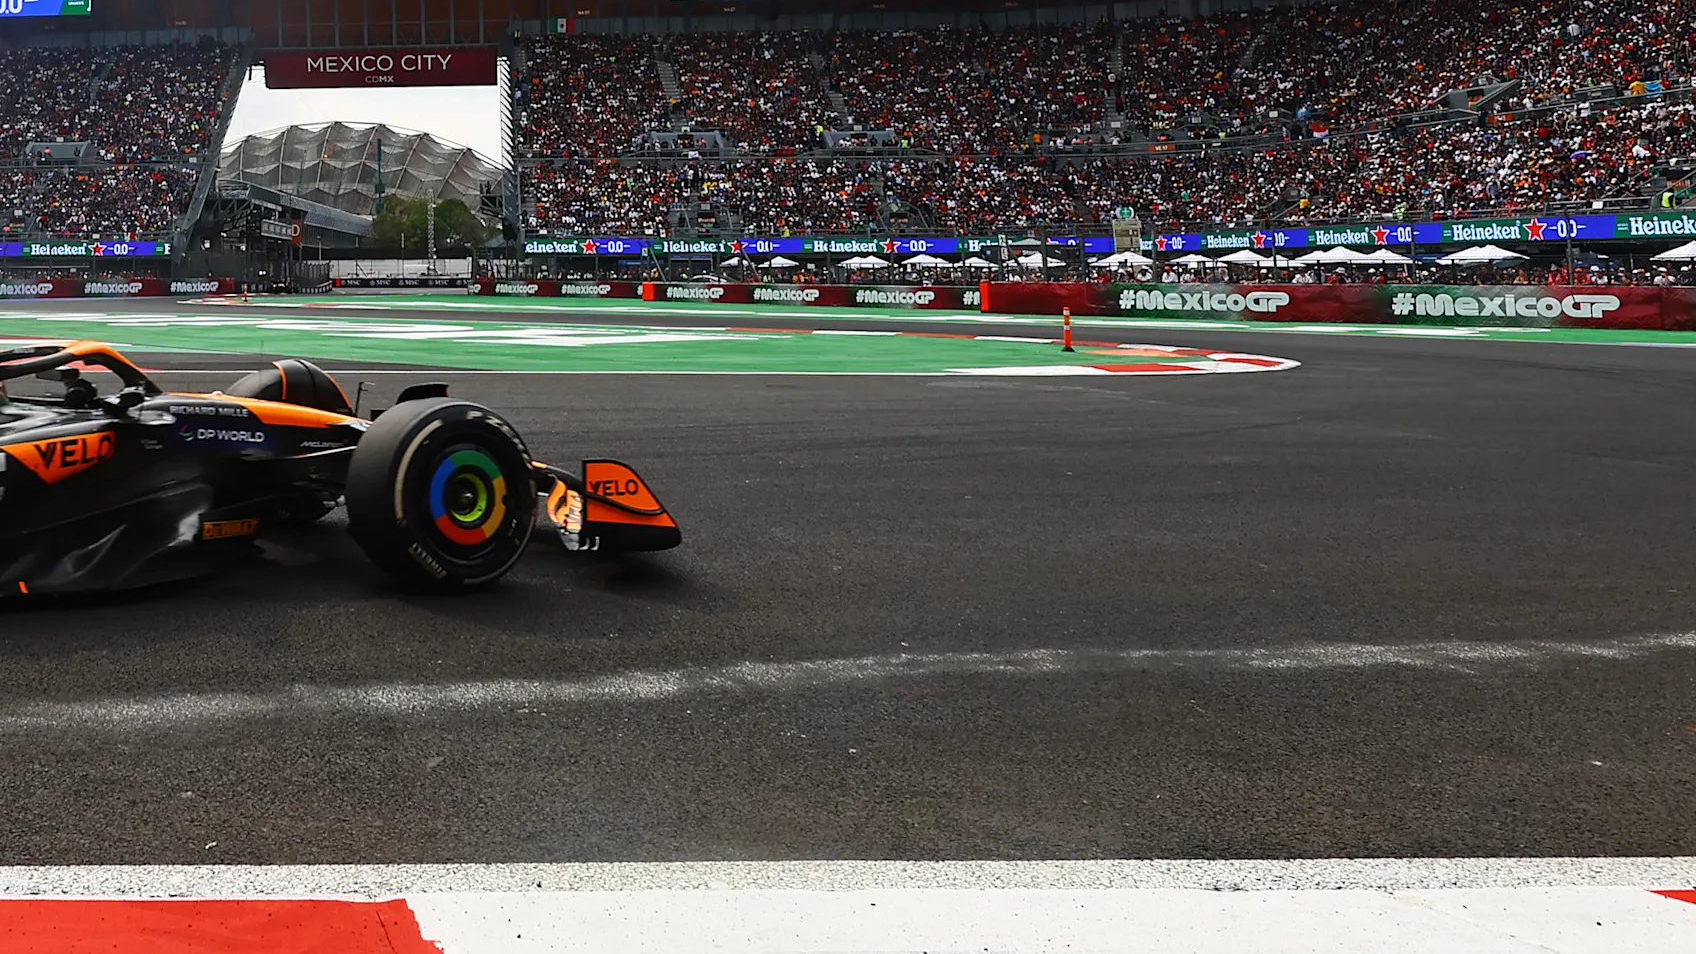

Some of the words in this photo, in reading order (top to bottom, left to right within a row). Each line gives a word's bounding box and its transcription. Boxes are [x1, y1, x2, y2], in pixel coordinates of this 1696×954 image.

[308, 56, 393, 71] MEXICO
[402, 55, 451, 70] CITY
[525, 241, 577, 253] eineken
[754, 288, 819, 302] #MexicoGP
[856, 290, 934, 306] #MexicoGP
[1119, 290, 1289, 313] #MexicoGP
[1392, 292, 1620, 320] #MexicoGP
[170, 406, 216, 416] RICHARD
[219, 407, 249, 417] MILLE
[197, 429, 216, 440] DP
[218, 430, 265, 443] WORLD
[35, 435, 113, 470] VELO
[589, 478, 639, 496] VELO
